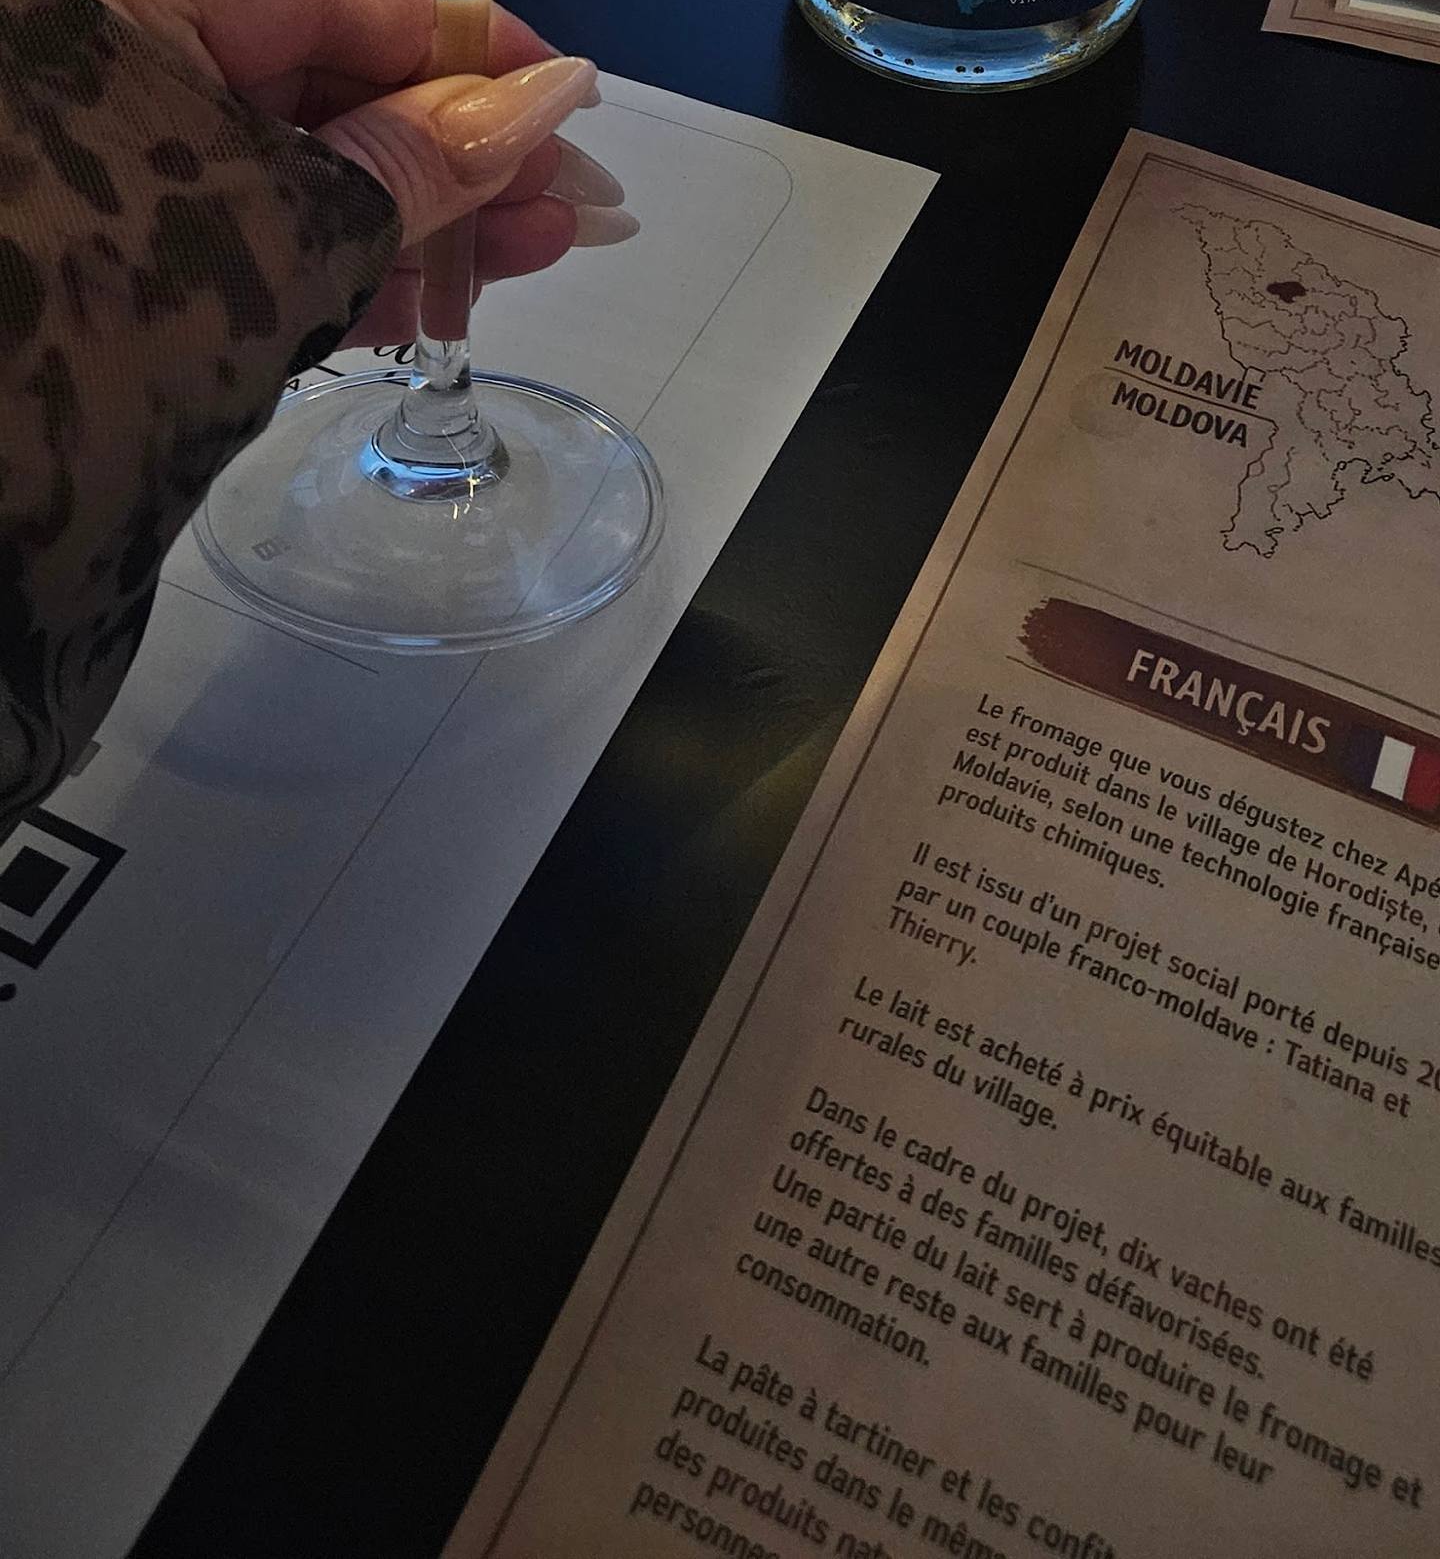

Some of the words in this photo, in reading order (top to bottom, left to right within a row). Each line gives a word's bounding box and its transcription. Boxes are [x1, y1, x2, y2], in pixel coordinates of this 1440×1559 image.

[1111, 382, 1249, 448] MOLDOVA
[1113, 339, 1267, 411] MOLDAVIE
[976, 693, 1004, 720] Le
[1009, 705, 1103, 758] fromage
[1108, 748, 1152, 776] que
[1160, 767, 1212, 801] vous
[1218, 789, 1325, 850] dégustez
[1332, 839, 1388, 876] chez
[1126, 649, 1332, 755] FRANÇAIS
[936, 784, 1037, 834] produits
[1042, 822, 1165, 889] chimiques.
[952, 749, 1053, 809] Moldavie,
[1061, 797, 1124, 835] selon
[1130, 825, 1174, 855] une
[1181, 842, 1320, 918] technologie
[1327, 902, 1440, 971] française
[965, 727, 1002, 751] est
[1003, 741, 1090, 786] produit
[1095, 773, 1151, 810] dans
[1156, 794, 1178, 821] le
[1186, 812, 1261, 857] village
[1267, 844, 1297, 872] de
[889, 905, 977, 967] Thierry.
[895, 880, 942, 906] par
[945, 898, 977, 924] un
[982, 914, 1061, 960] couple
[1067, 943, 1259, 1049] franco-moldave
[1285, 1039, 1375, 1104] Tatiana
[1383, 1092, 1411, 1119] et
[912, 841, 932, 867] Il
[933, 856, 972, 884] est
[975, 867, 1024, 906] issu
[1084, 920, 1163, 966] projet
[1167, 955, 1240, 1000] social
[1242, 990, 1316, 1035] porté
[1322, 1020, 1409, 1077] depuis
[838, 1017, 927, 1069] rurales
[932, 1054, 966, 1087] du
[974, 1075, 1057, 1131] village.
[853, 975, 884, 1007] Le
[888, 989, 931, 1028] lait
[934, 1017, 975, 1048] est
[978, 1037, 1064, 1087] acheté
[1067, 1070, 1085, 1099] à
[1087, 1087, 1145, 1127] prix
[1151, 1111, 1273, 1188] équitable
[1279, 1177, 1330, 1216] aux
[1338, 1195, 1440, 1269] familles
[736, 1253, 930, 1367] consommation.
[789, 1129, 893, 1193] offertes
[897, 1174, 915, 1205] à
[920, 1188, 968, 1229] des
[974, 1209, 1079, 1284] familles
[1085, 1268, 1264, 1380] défavorisées.
[805, 1085, 869, 1135] Dans
[872, 1115, 898, 1149] le
[903, 1138, 976, 1185] cadre
[982, 1170, 1017, 1206] du
[1020, 1194, 1108, 1257] projet,
[1118, 1237, 1162, 1279] dix
[1171, 1265, 1263, 1329] vaches
[1271, 1317, 1321, 1357] ont
[1328, 1337, 1374, 1383] été
[753, 1211, 803, 1249] une
[807, 1237, 880, 1287] autre
[884, 1275, 957, 1326] reste
[962, 1314, 1013, 1356] aux
[1020, 1334, 1128, 1415] familles
[1132, 1401, 1206, 1451] pour
[1212, 1431, 1274, 1485] leur
[772, 1164, 823, 1209] Une
[823, 1198, 907, 1250] partie
[912, 1234, 948, 1272] du
[953, 1250, 999, 1297] lait
[1003, 1285, 1064, 1329] sert
[1068, 1309, 1086, 1342] à
[1089, 1329, 1215, 1407] produire
[1222, 1385, 1250, 1424] le
[1258, 1402, 1383, 1491] fromage
[1391, 1476, 1423, 1510] et
[655, 1430, 706, 1478] des
[705, 1465, 829, 1546] produits
[671, 1387, 808, 1472] produites
[813, 1454, 882, 1511] dans
[886, 1487, 915, 1529] le
[921, 1515, 1008, 1559] mêm
[694, 1334, 730, 1376] La
[729, 1362, 794, 1408] pâte
[798, 1387, 818, 1422] à
[824, 1402, 936, 1479] tartiner
[940, 1469, 972, 1502] et
[977, 1478, 1020, 1528] les
[628, 1482, 780, 1559] personne
